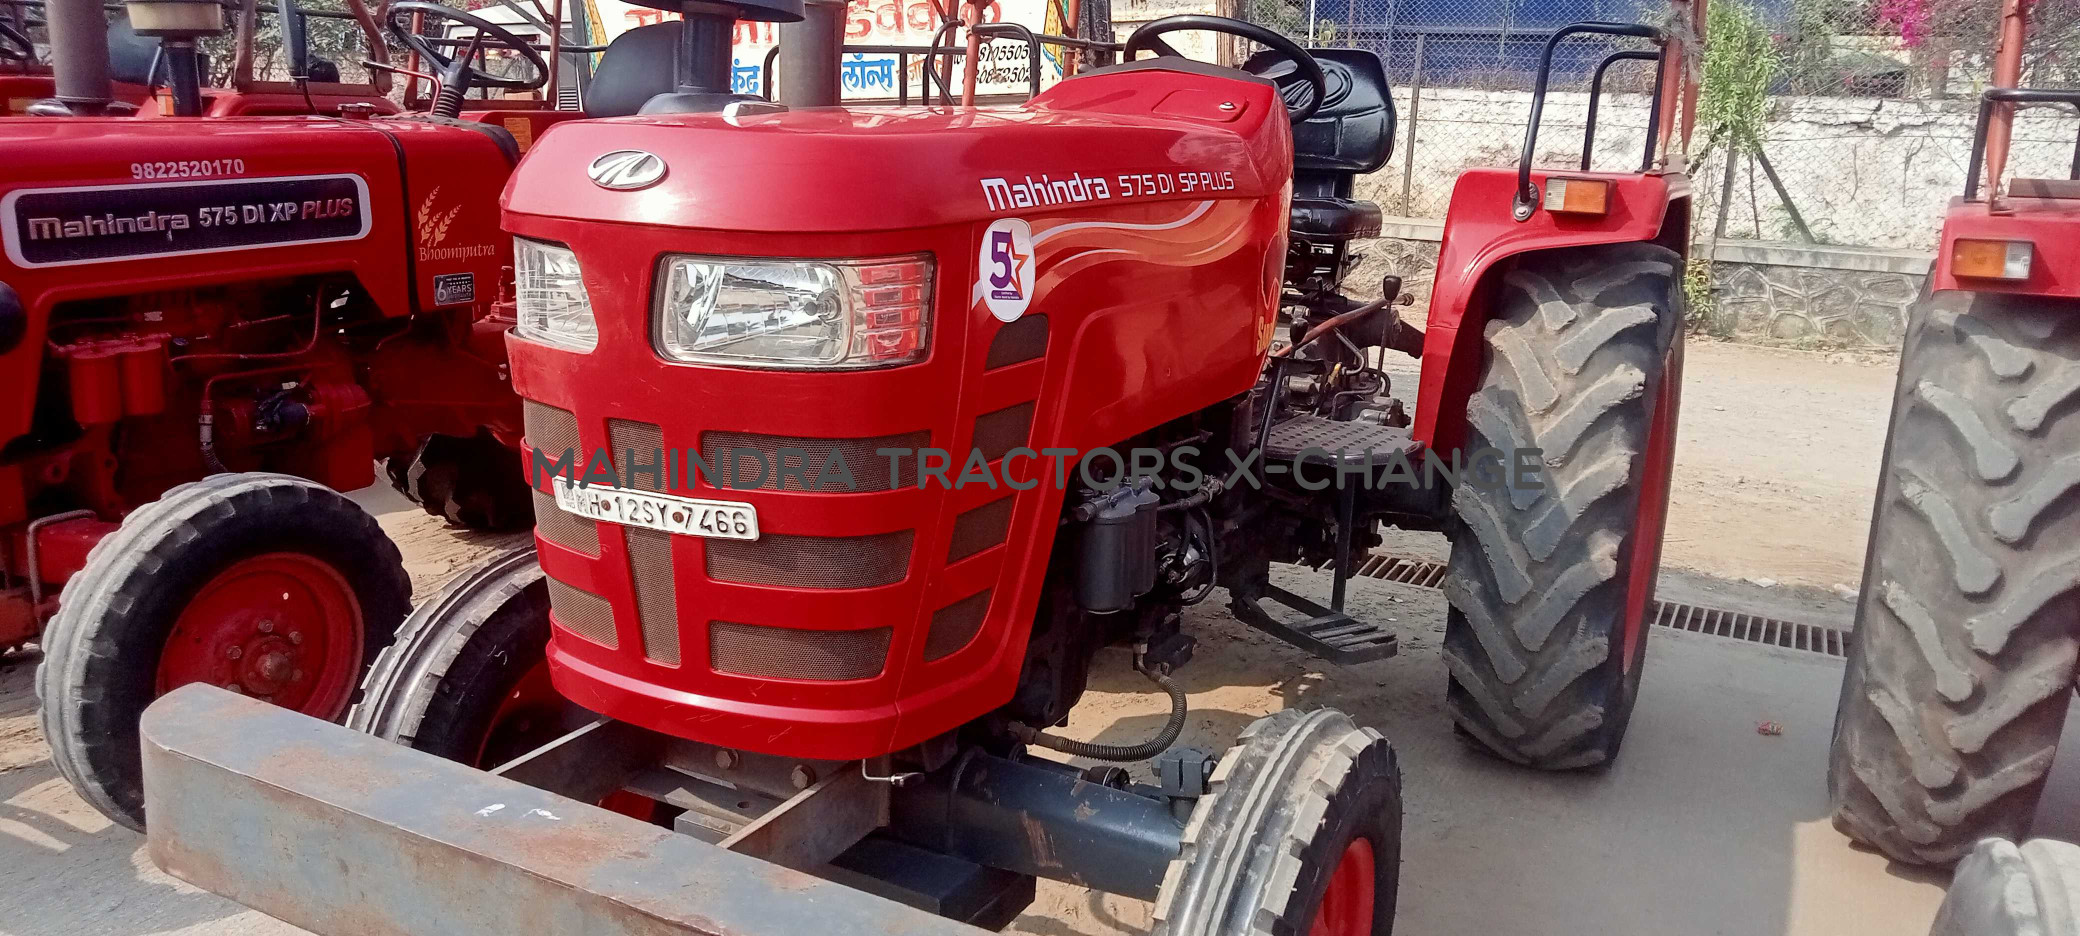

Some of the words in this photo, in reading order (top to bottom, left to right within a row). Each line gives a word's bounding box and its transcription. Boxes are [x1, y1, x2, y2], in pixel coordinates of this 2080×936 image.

[131, 158, 244, 179] 9822520170
[980, 172, 1111, 211] Mahindra
[1118, 173, 1157, 197] 575
[1158, 173, 1175, 194] DI
[1179, 171, 1199, 193] SP
[1200, 171, 1235, 191] PLUS
[28, 210, 189, 241] Mahindra
[199, 206, 238, 228] 575
[243, 204, 266, 225] DI
[269, 202, 299, 223] XP
[302, 198, 353, 221] PLUS
[420, 243, 496, 262] Bhoomiputra
[989, 230, 1012, 289] 5
[437, 281, 447, 302] 6
[447, 284, 472, 294] YEARS
[614, 496, 668, 527] 12SY
[682, 505, 748, 535] 7466
